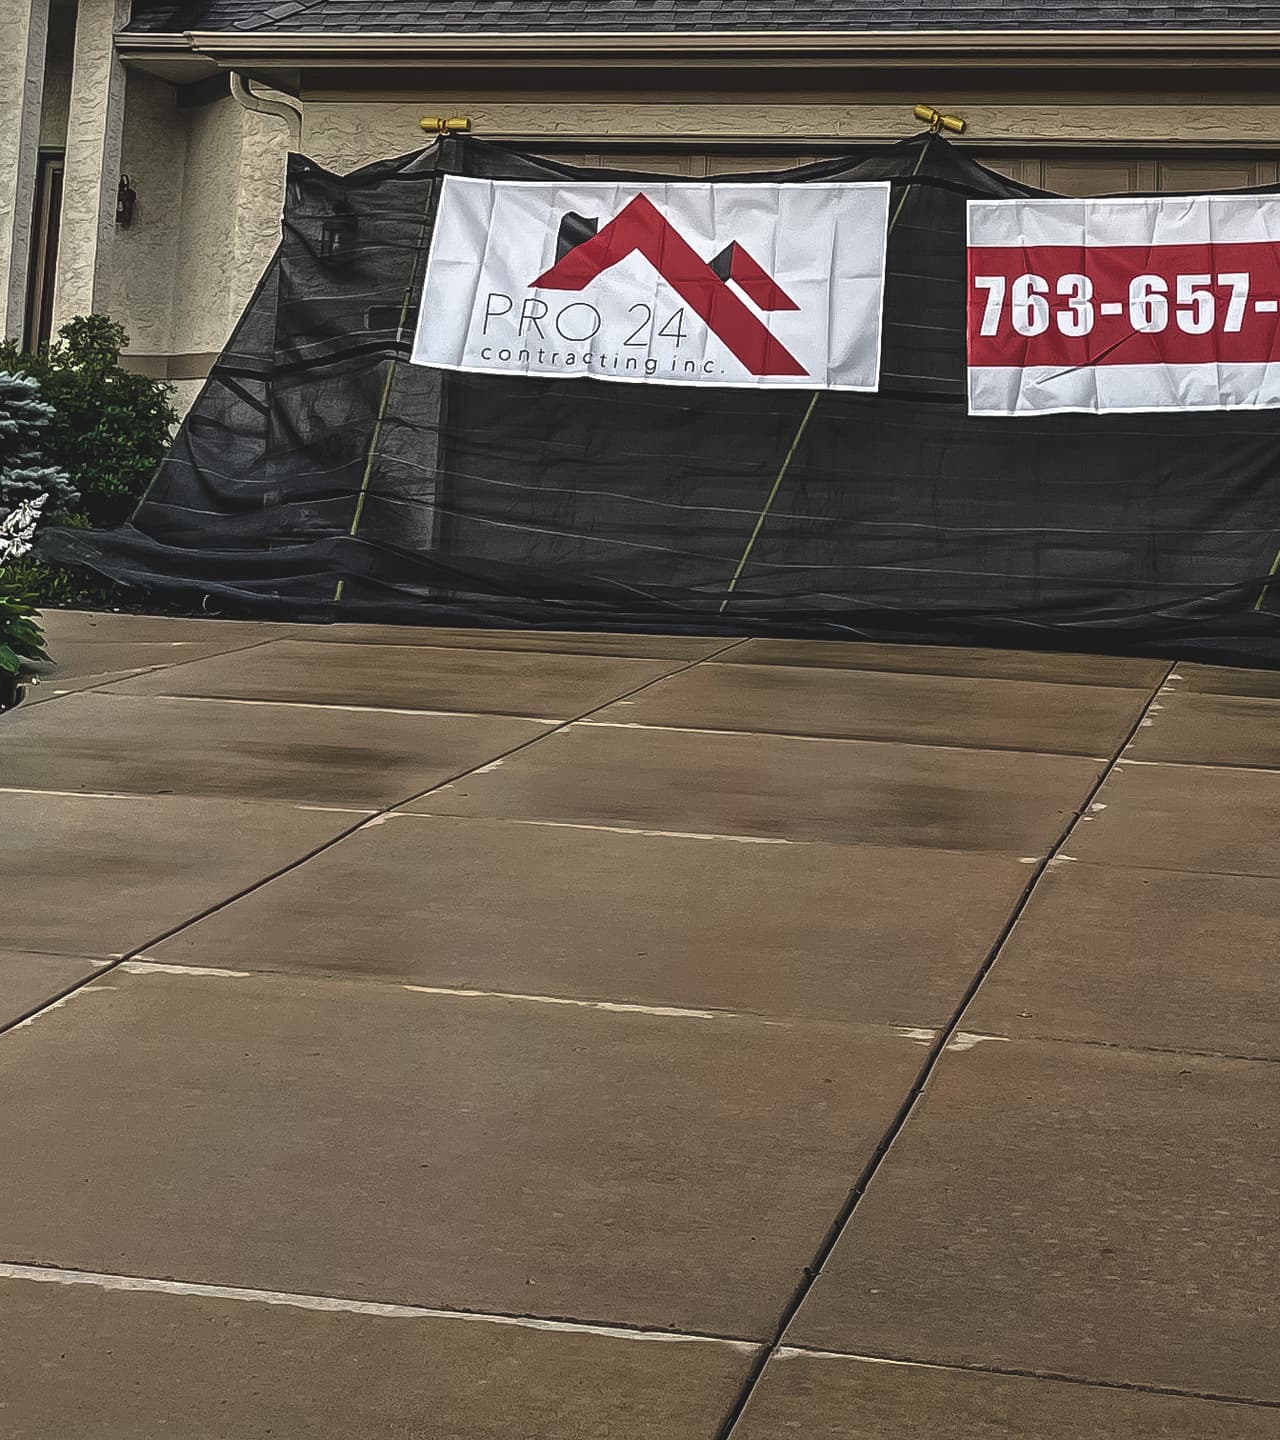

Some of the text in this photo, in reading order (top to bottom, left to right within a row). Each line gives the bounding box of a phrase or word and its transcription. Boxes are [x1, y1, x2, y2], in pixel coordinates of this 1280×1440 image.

[483, 293, 687, 348] PRO 24
[481, 346, 726, 375] contracting inc.
